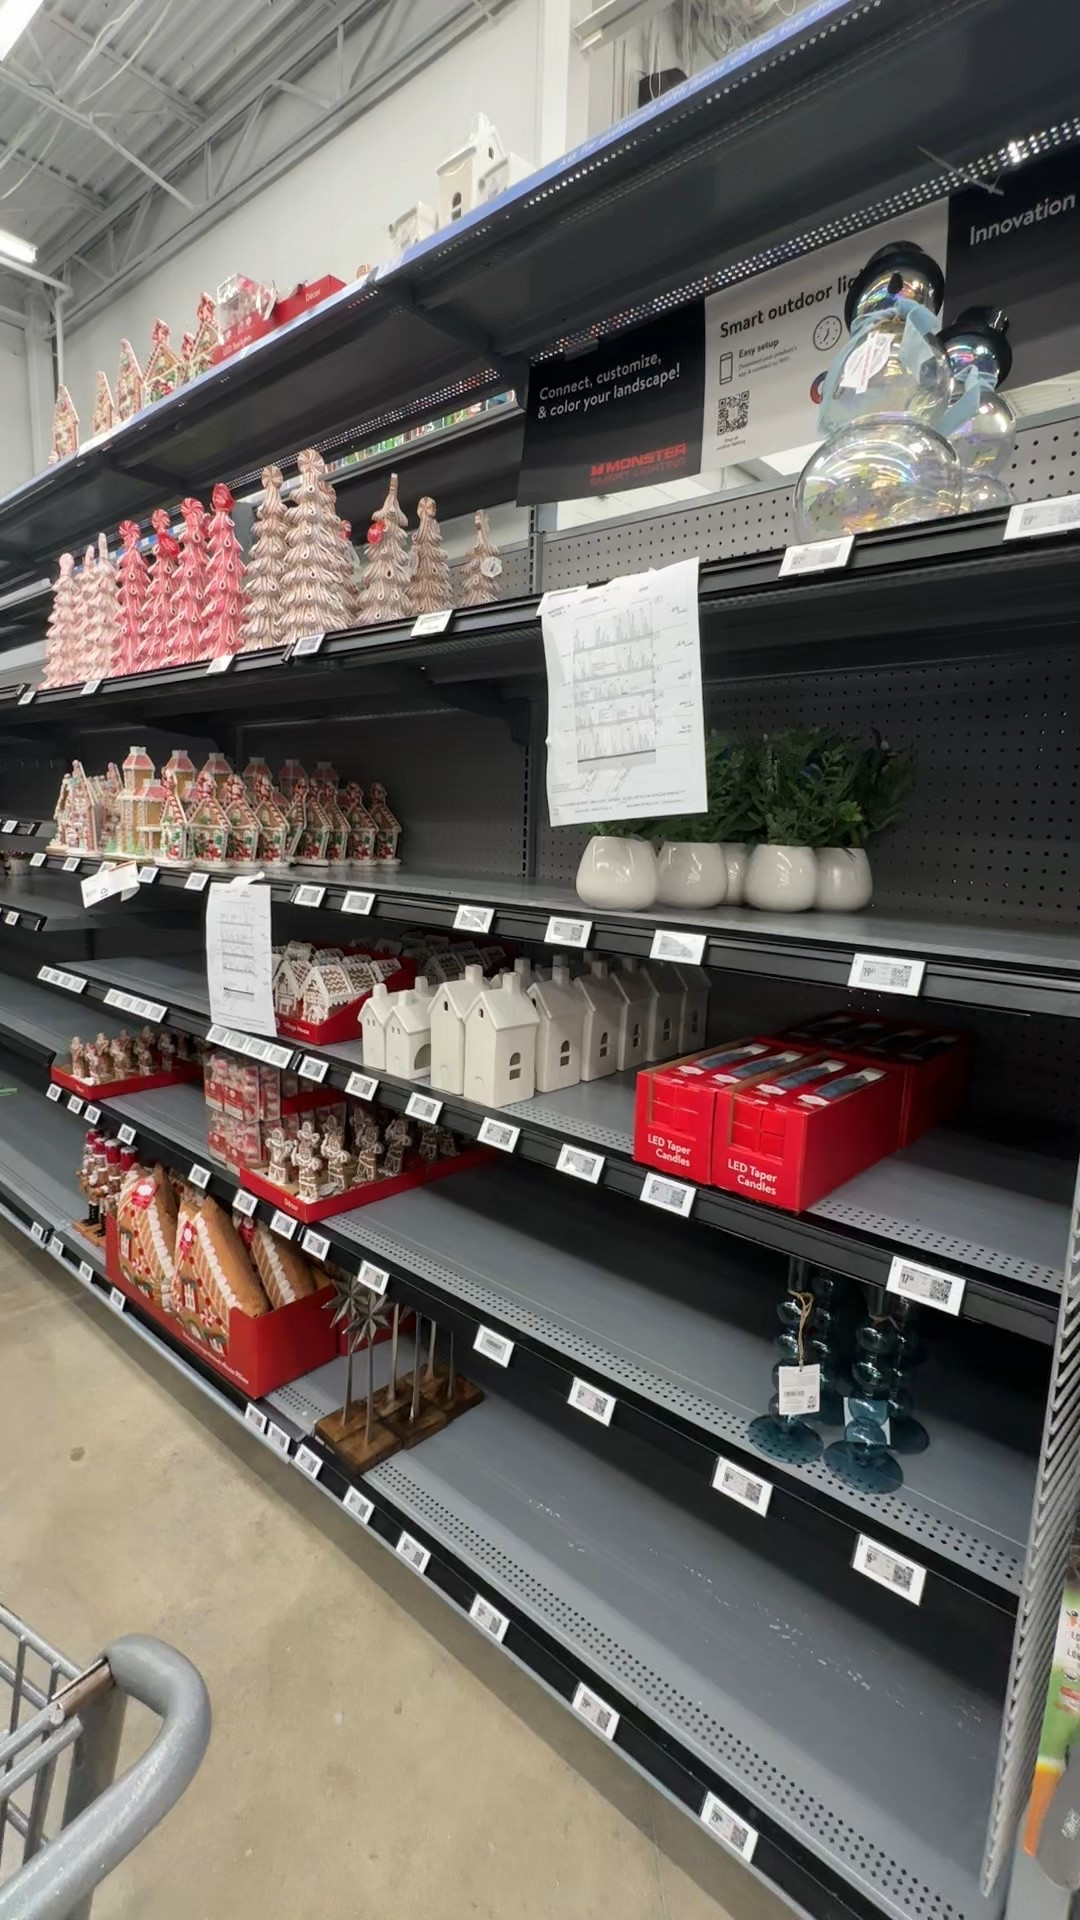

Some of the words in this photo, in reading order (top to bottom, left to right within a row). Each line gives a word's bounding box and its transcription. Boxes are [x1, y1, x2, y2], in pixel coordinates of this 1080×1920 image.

[969, 194, 1076, 246] Innovation
[720, 310, 764, 338] Smart
[768, 286, 833, 320] outdoor
[738, 346, 756, 358] Easy
[757, 339, 779, 352] setup
[537, 406, 547, 419] &
[550, 399, 581, 416] color
[583, 390, 611, 412] your
[613, 362, 681, 399] landscape!
[539, 376, 593, 400] Connect,
[596, 352, 662, 384] customize,
[590, 470, 631, 486] SMART
[634, 457, 687, 478] LIGHTING
[606, 443, 687, 473] MONSTER
[647, 1133, 665, 1148] LED
[667, 1138, 692, 1156] Taper
[656, 1148, 691, 1168] Candles
[728, 1157, 748, 1174] LED
[749, 1164, 777, 1184] Taper
[736, 1174, 777, 1197] Candles
